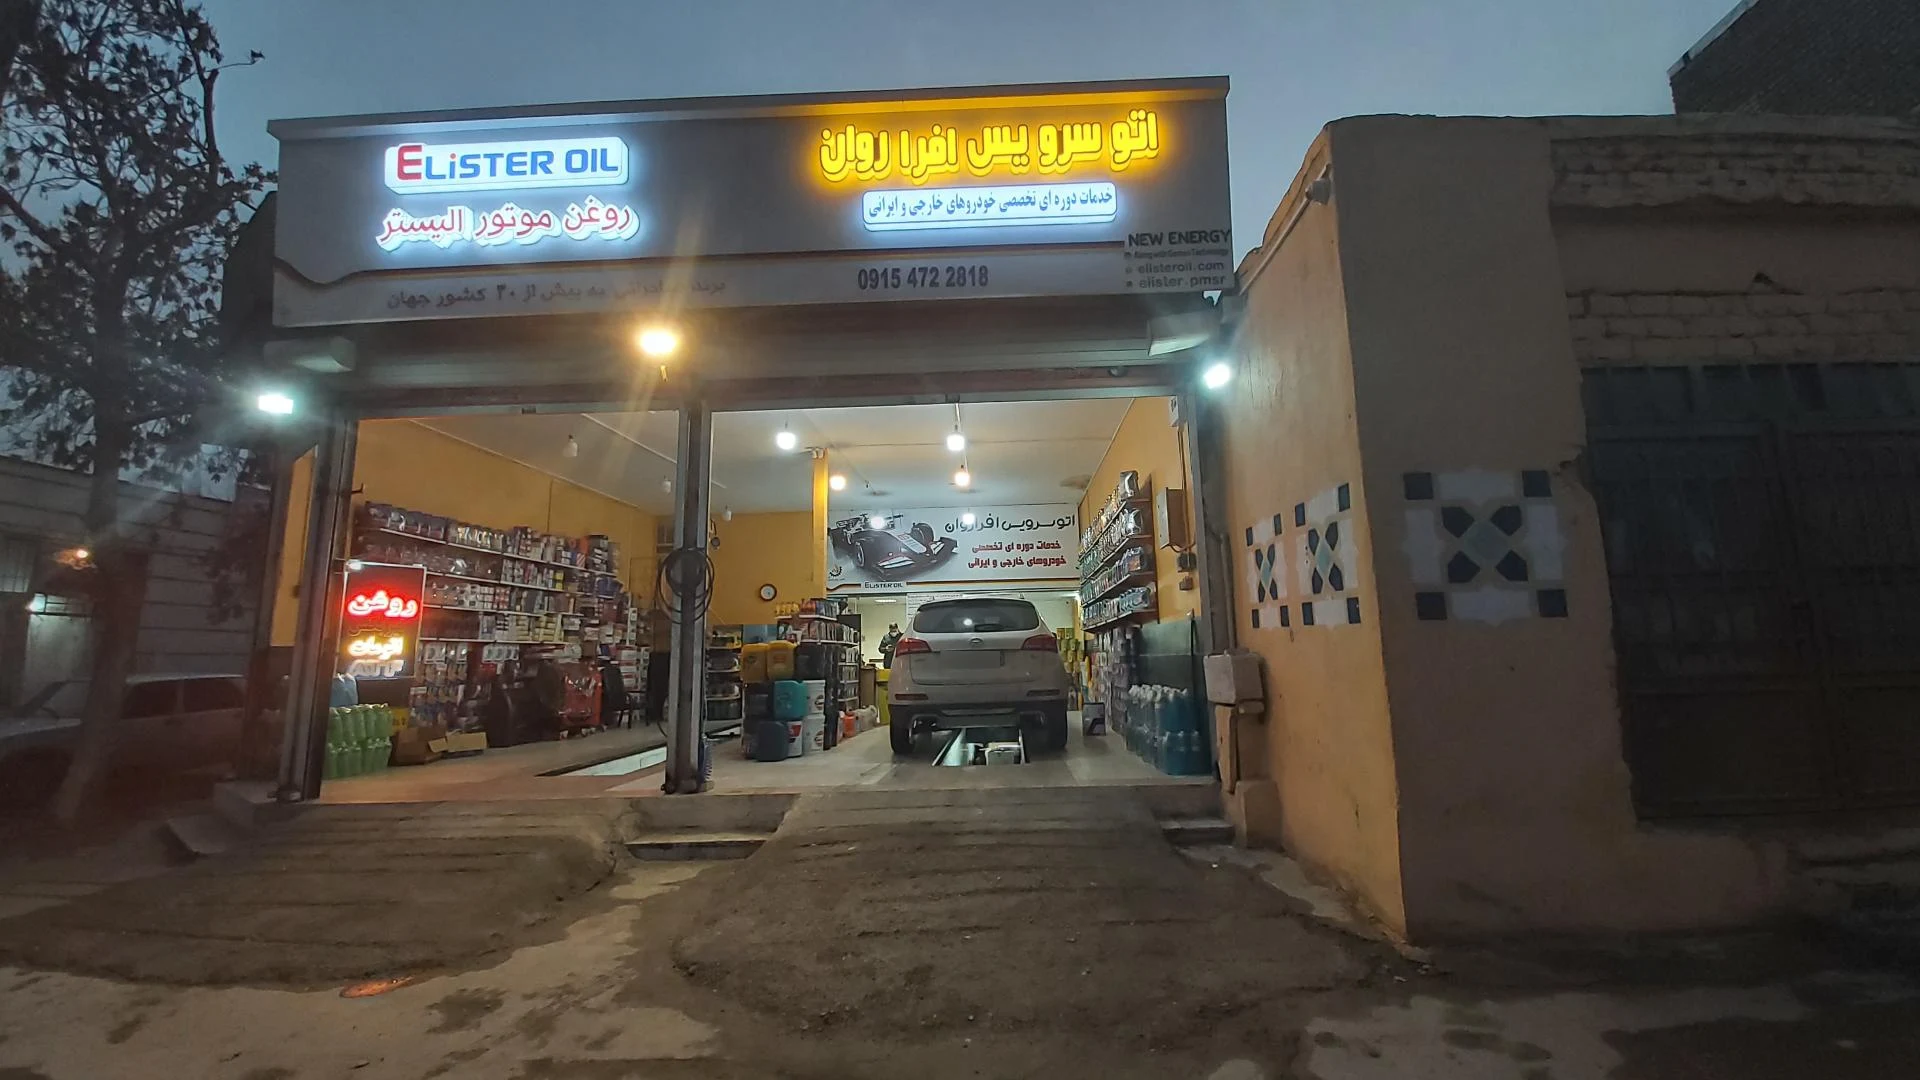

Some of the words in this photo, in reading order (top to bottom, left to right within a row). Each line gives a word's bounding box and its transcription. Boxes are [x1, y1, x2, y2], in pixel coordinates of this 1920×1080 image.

[1111, 110, 1159, 163] اتو
[565, 148, 618, 173] OIL
[820, 125, 891, 174] روان
[900, 124, 957, 178] افرا
[868, 193, 898, 217] ایرانی
[909, 194, 943, 216] خارجی
[946, 193, 996, 215] خودروهای
[999, 190, 1036, 212] تخصصی
[1079, 187, 1112, 204] خدمات
[380, 209, 463, 242] الیستر
[475, 206, 552, 237] موتور
[565, 197, 631, 233] روغن
[1128, 232, 1164, 247] NEW
[1168, 229, 1231, 245] ENERGY
[858, 267, 901, 290] 0915
[907, 266, 940, 288] 472
[945, 265, 989, 288] 2818
[387, 290, 431, 310] جهان
[436, 287, 487, 308] کشور
[1037, 540, 1061, 550] خدمات
[968, 557, 990, 569] ایرانی
[1000, 556, 1024, 568] خارجی
